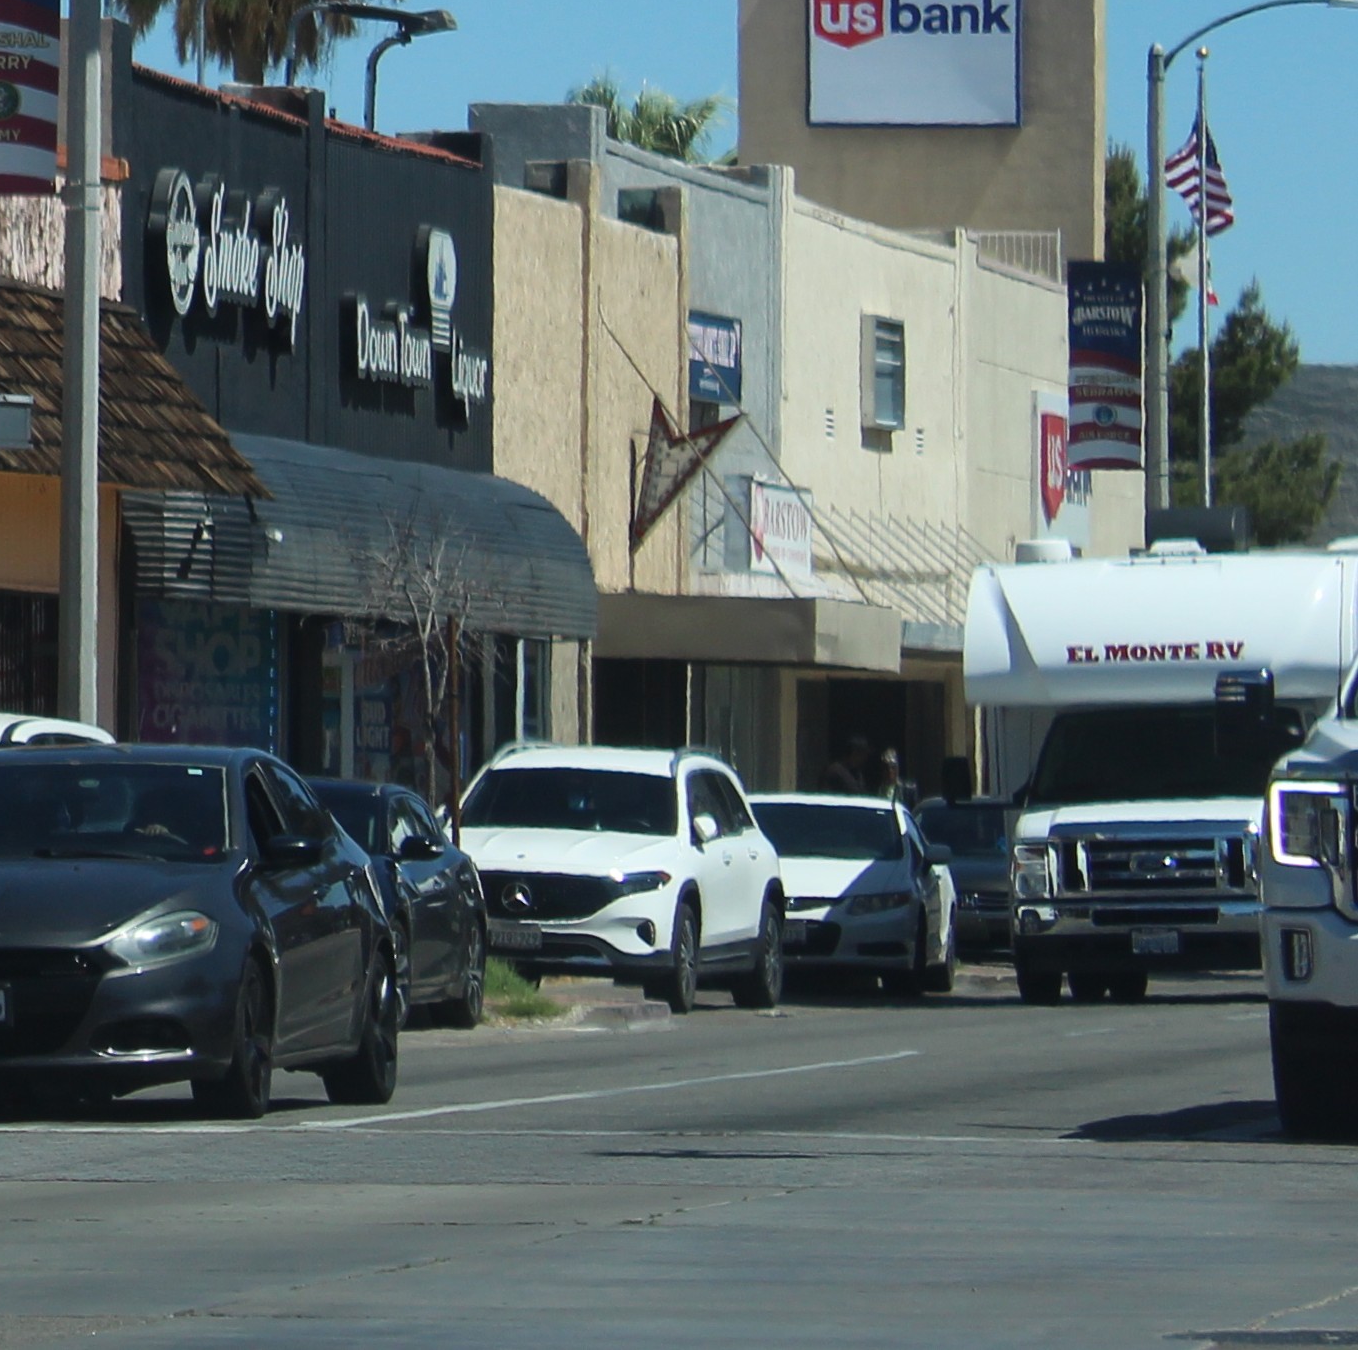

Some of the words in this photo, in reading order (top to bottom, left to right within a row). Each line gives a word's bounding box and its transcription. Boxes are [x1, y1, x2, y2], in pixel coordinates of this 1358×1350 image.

[204, 181, 259, 307] Smoke
[266, 198, 304, 343] Shop
[1073, 306, 1135, 328] BARSTOW
[452, 333, 487, 419] Liquor
[1067, 645, 1099, 664] EL
[1105, 642, 1199, 662] MONTE
[1206, 640, 1244, 661] RV
